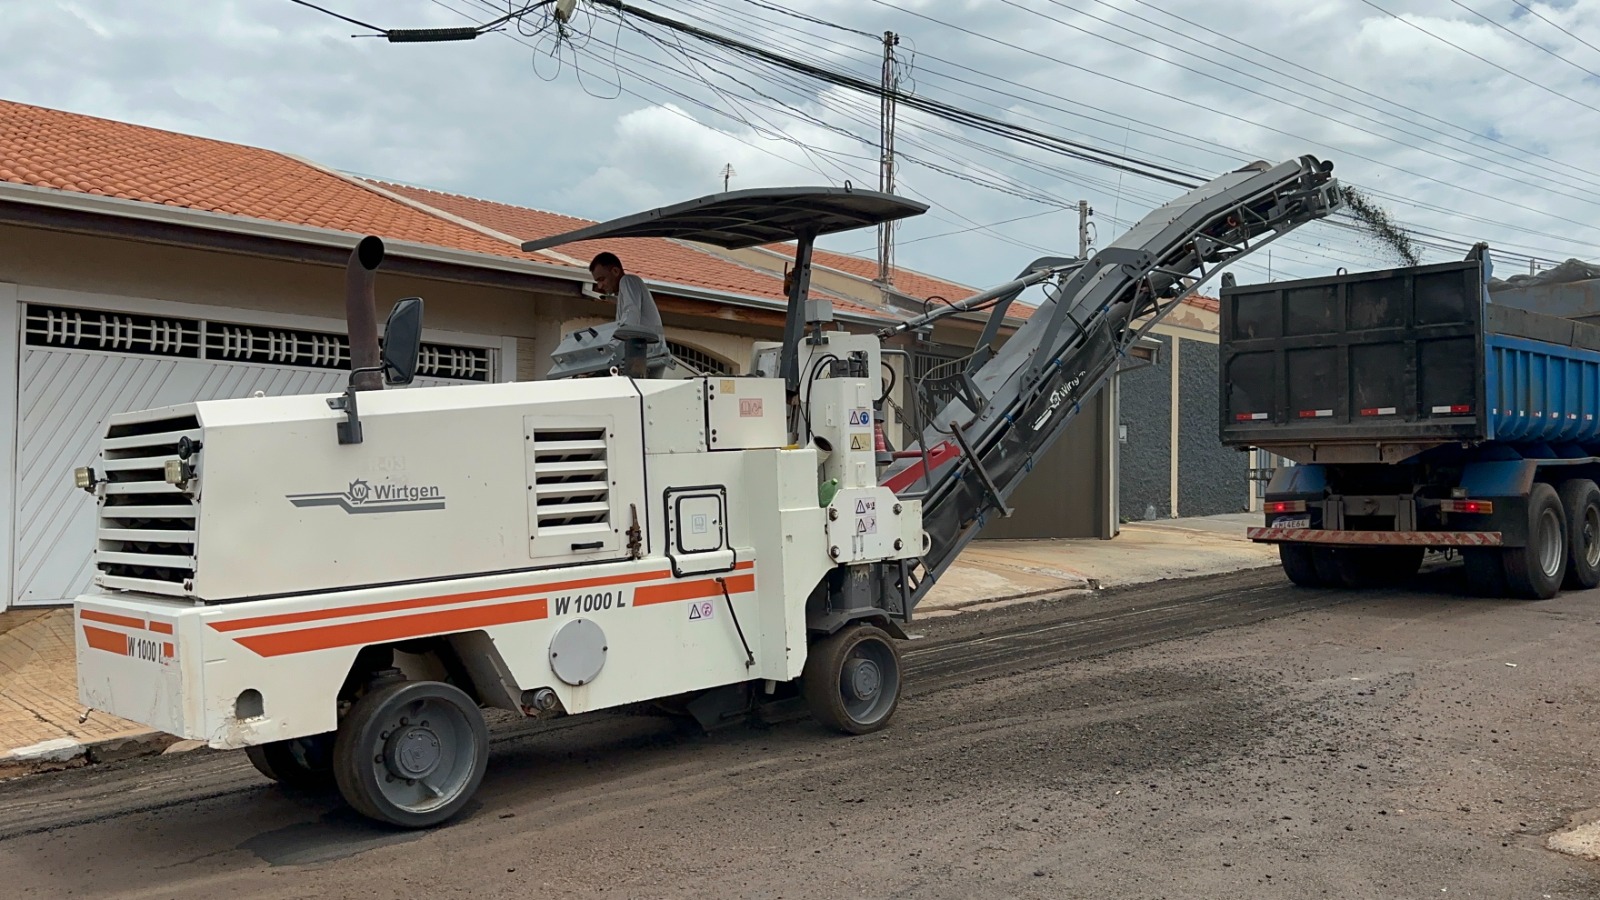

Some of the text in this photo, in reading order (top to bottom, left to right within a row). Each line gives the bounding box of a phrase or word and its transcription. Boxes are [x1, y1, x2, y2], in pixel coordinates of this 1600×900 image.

[354, 484, 439, 501] W Wirtgen
[555, 591, 626, 616] W 1000 L
[128, 636, 136, 657] W
[138, 638, 157, 662] 1000
